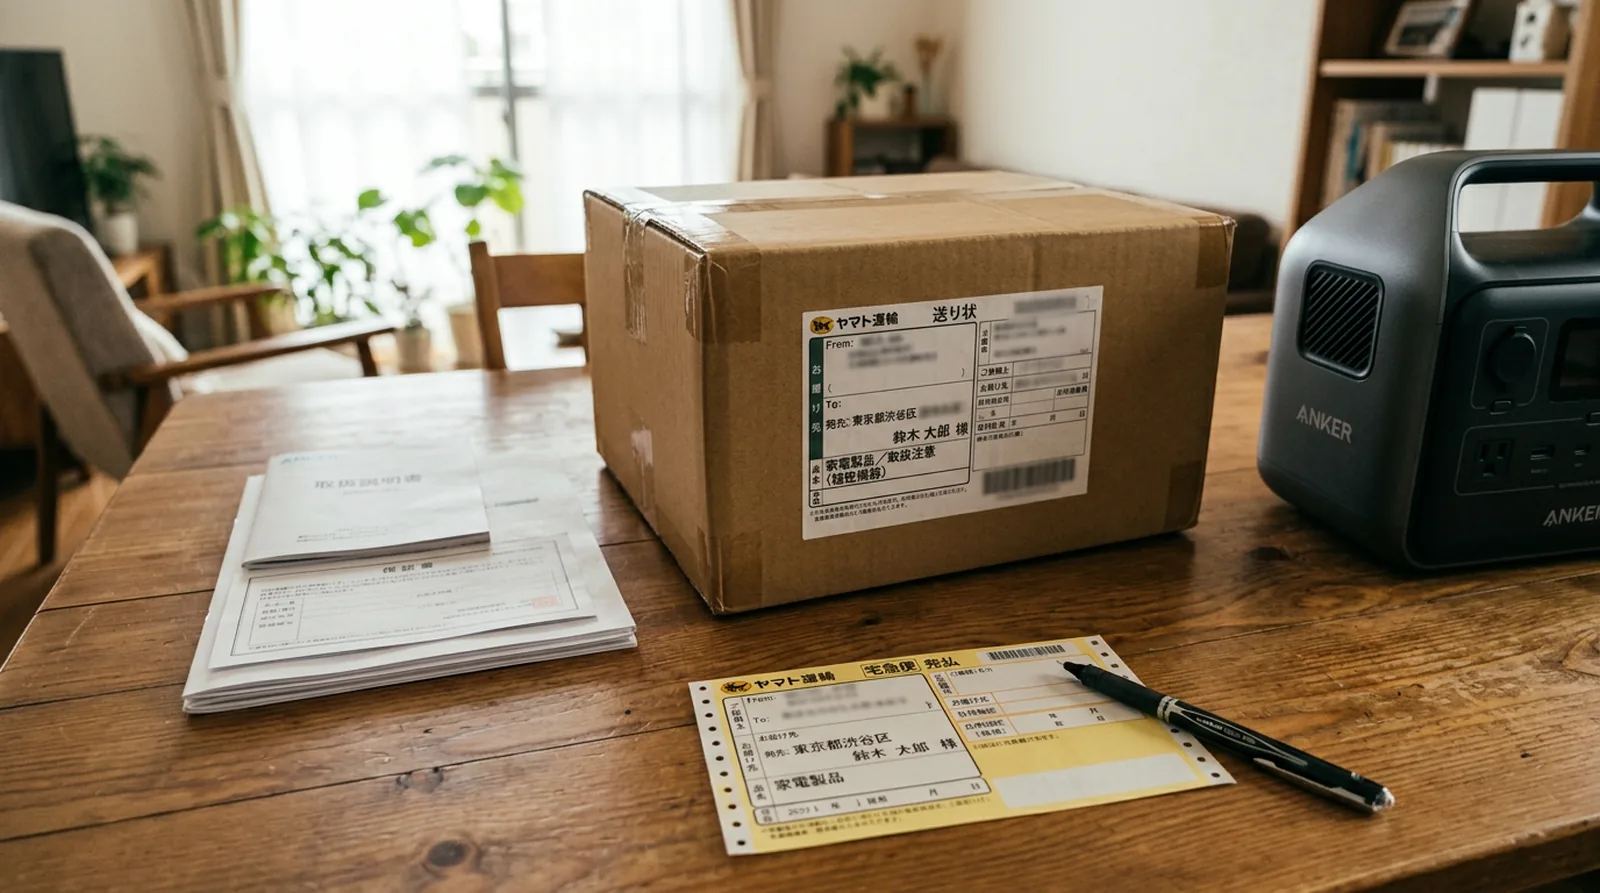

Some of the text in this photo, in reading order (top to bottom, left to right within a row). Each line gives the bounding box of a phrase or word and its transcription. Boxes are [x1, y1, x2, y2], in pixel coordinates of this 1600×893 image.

[836, 312, 899, 330] ヤマト運輸
[933, 303, 978, 323] 送り状
[1296, 404, 1353, 444] ANKER
[754, 671, 836, 689] ヤマト運輸
[864, 661, 917, 675] 宅急便
[793, 732, 892, 755] 東京都渋谷区
[940, 738, 958, 749] 様
[774, 772, 845, 791] 家電製品
